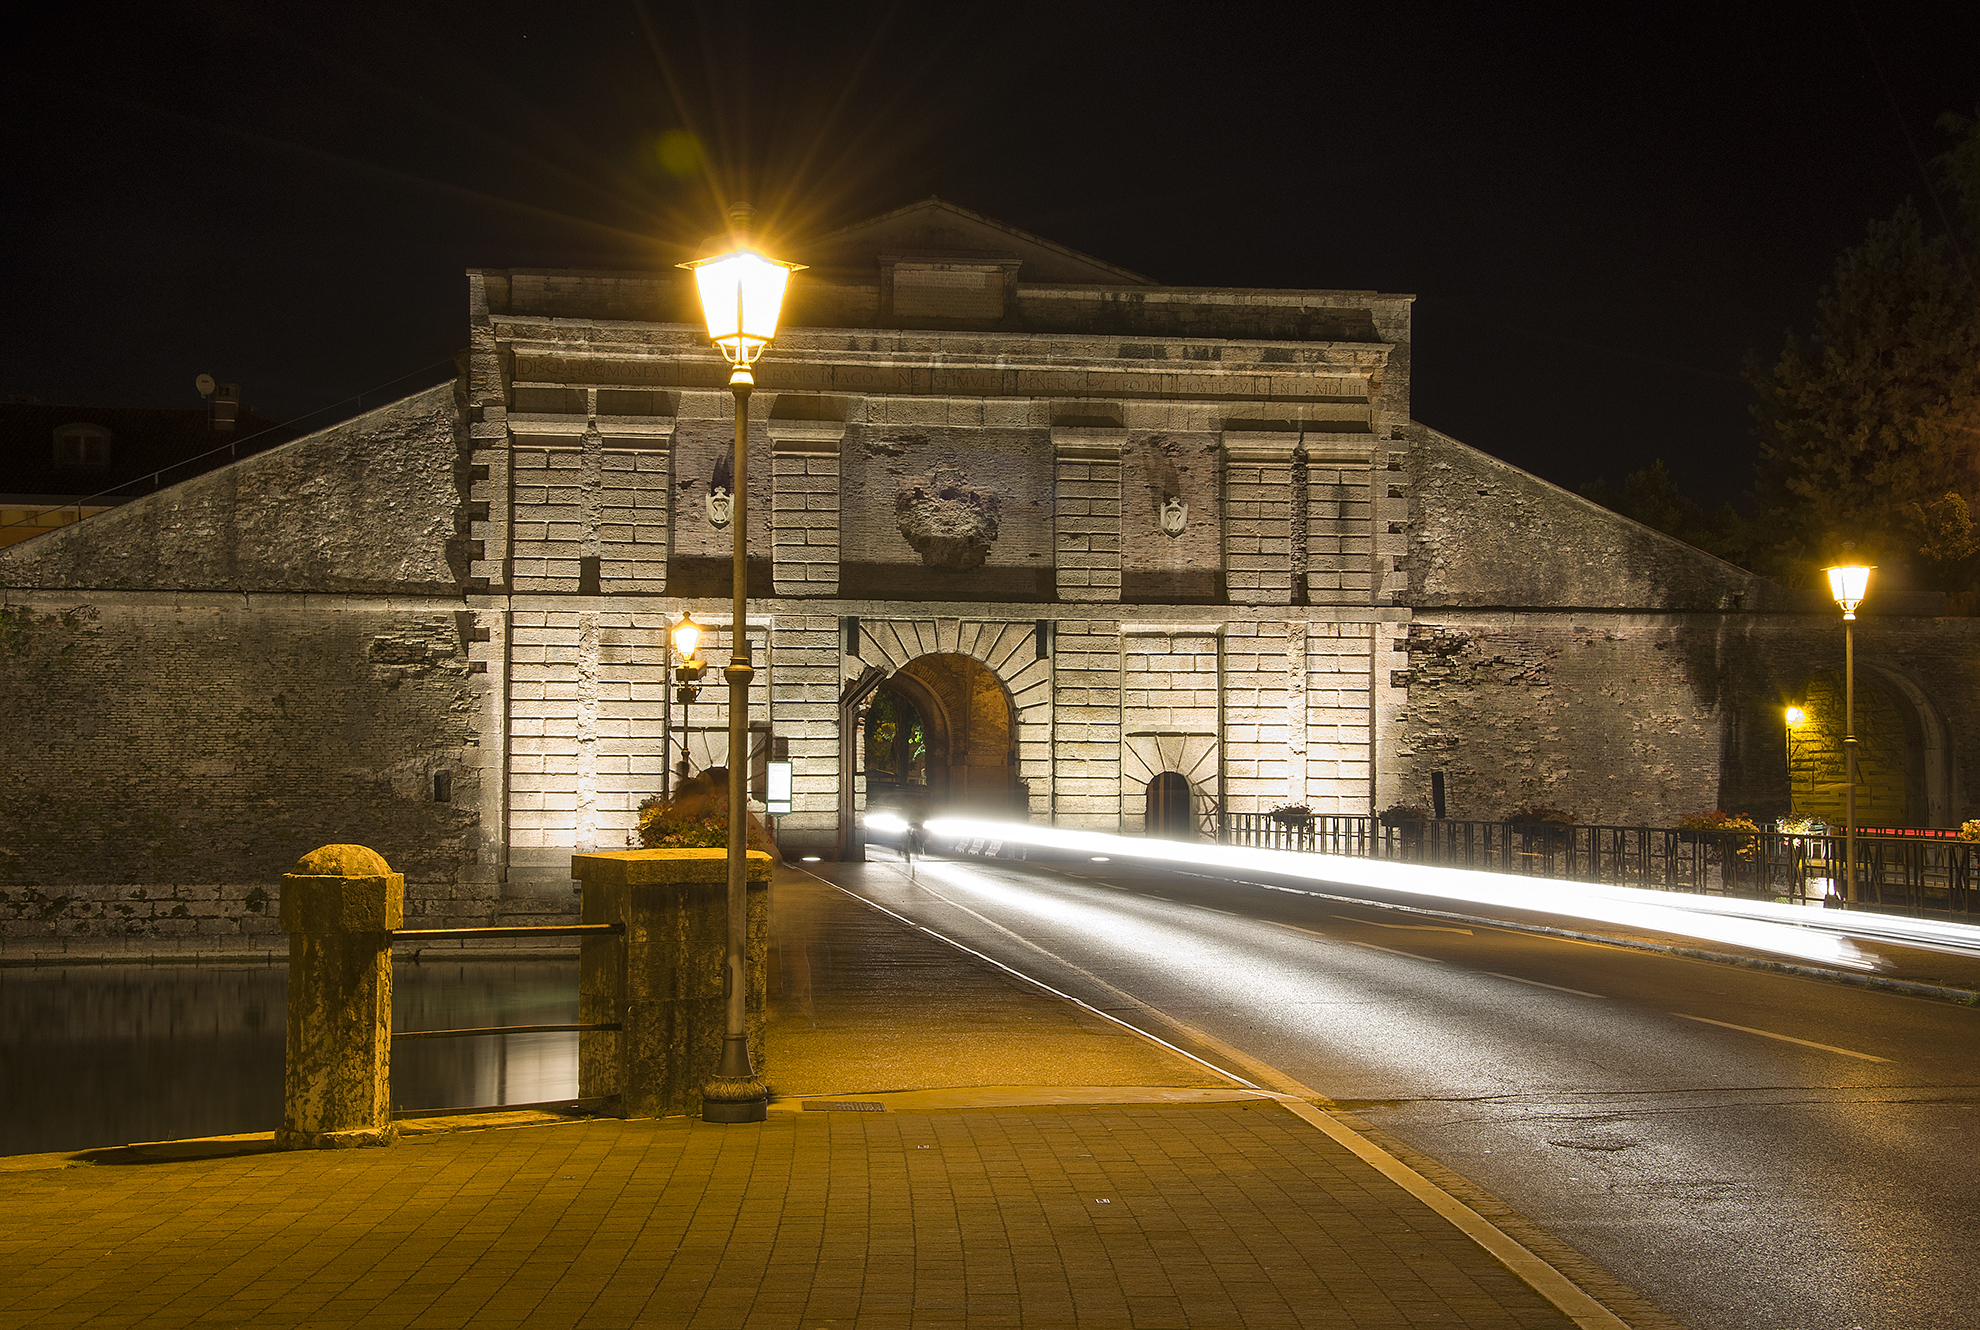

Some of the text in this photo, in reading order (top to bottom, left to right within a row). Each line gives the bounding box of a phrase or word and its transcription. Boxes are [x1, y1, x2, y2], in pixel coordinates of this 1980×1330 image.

[518, 358, 564, 375] DISCE
[607, 365, 671, 378] MONEAT
[764, 368, 814, 381] LEONIS
[821, 371, 873, 384] IMAGO
